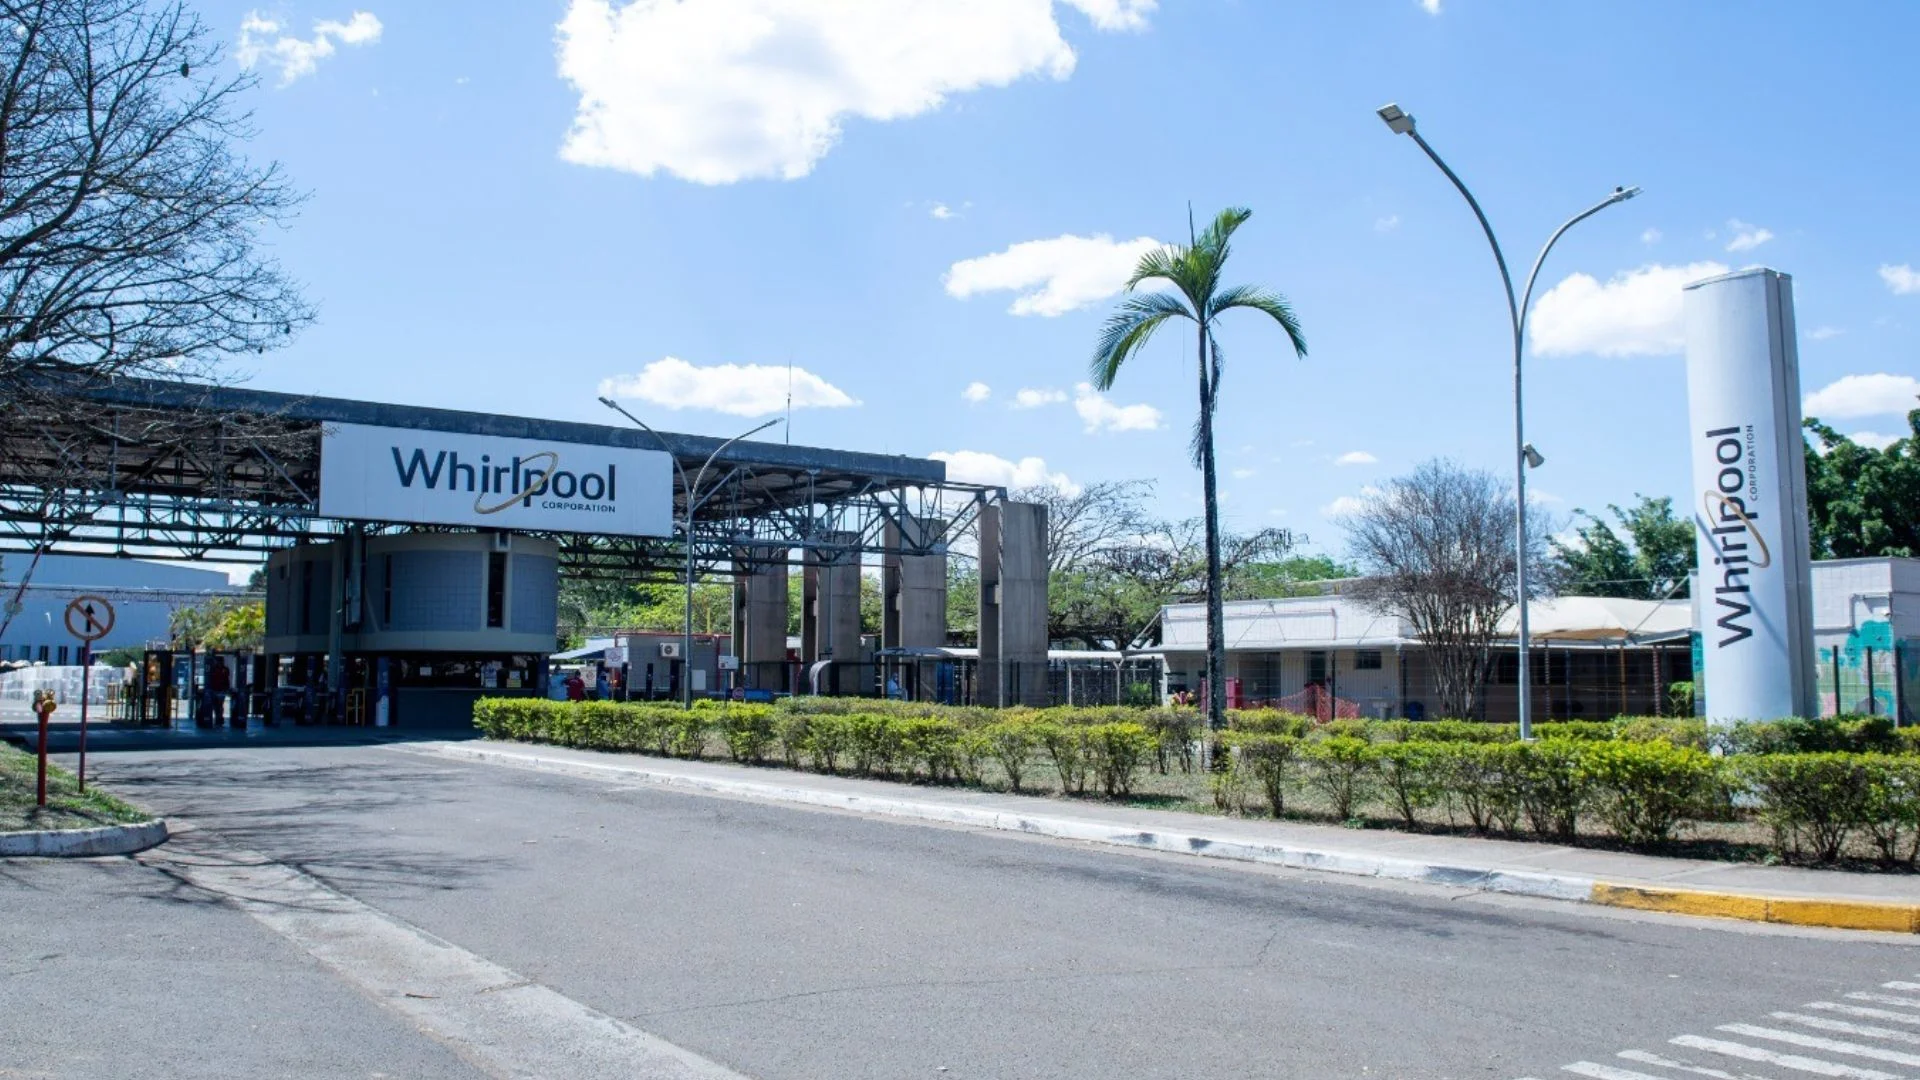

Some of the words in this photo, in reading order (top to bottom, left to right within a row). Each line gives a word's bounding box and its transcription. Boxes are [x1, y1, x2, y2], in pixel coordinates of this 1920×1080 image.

[390, 446, 616, 508] Whirlpool
[1746, 424, 1758, 502] CORPORATION
[541, 500, 616, 513] CORPORATION
[1706, 426, 1758, 648] Whirlpool
